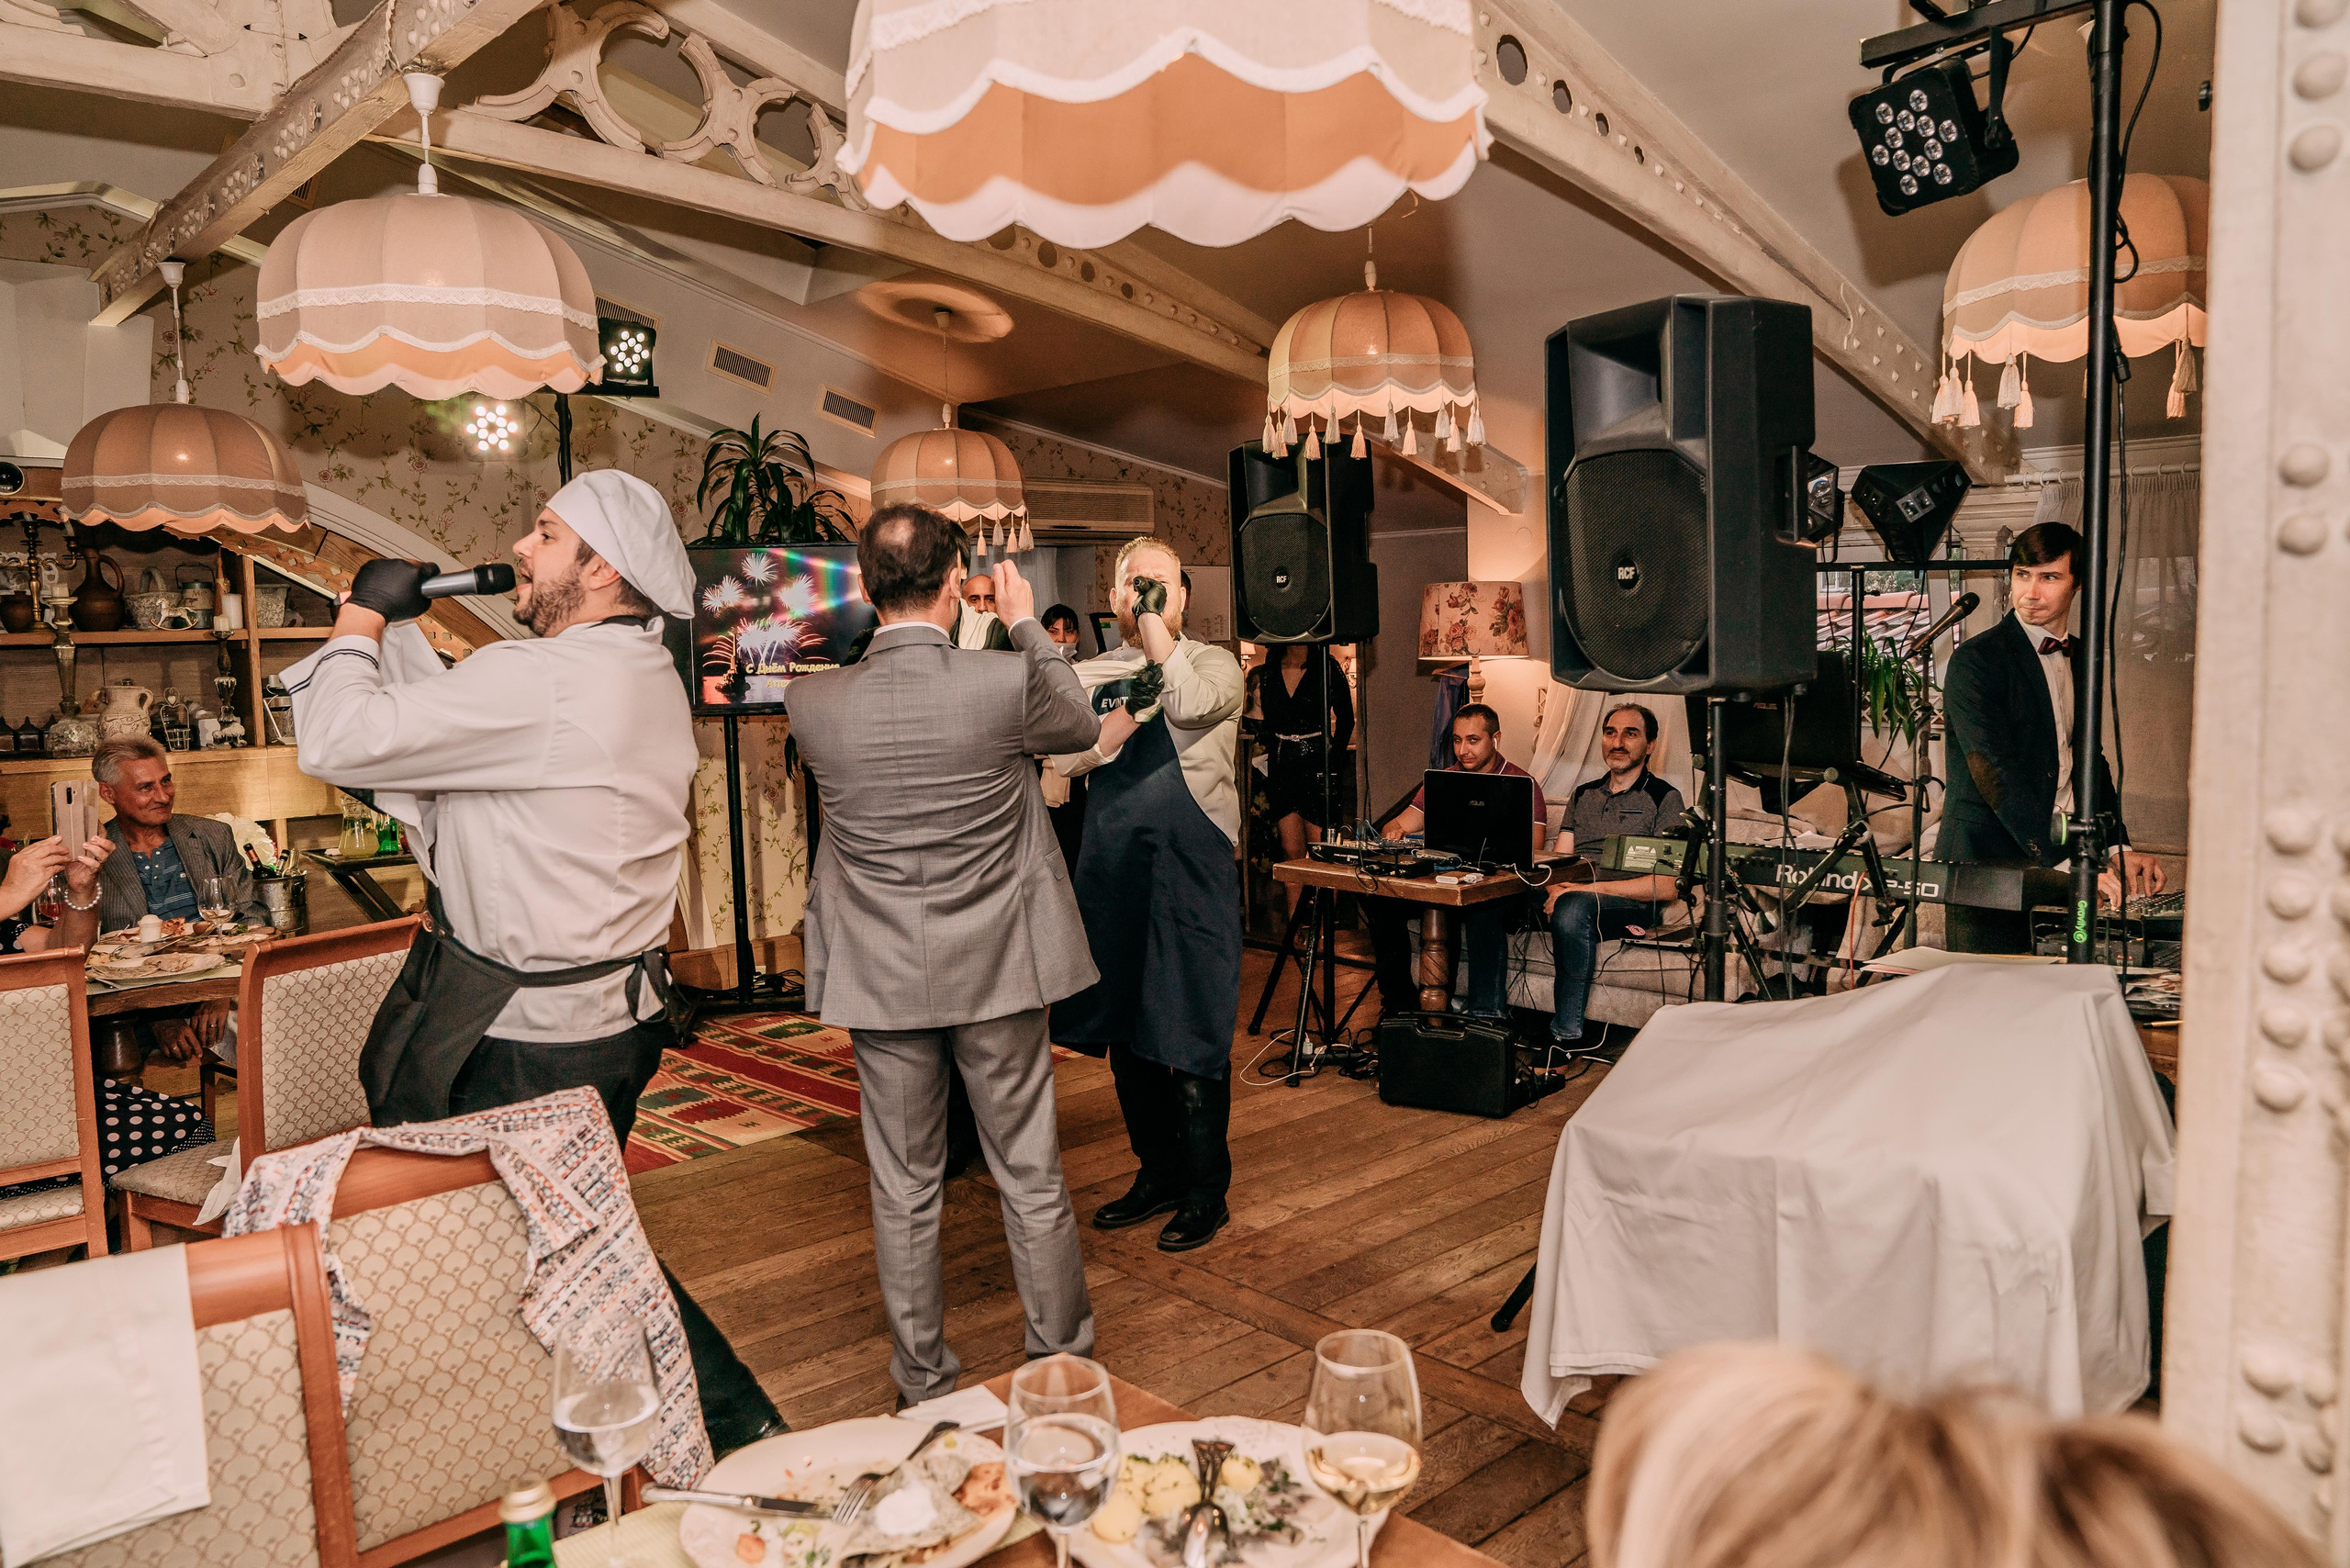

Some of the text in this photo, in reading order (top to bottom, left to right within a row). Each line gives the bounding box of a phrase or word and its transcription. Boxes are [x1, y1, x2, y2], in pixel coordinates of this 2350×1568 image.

[1276, 575, 1288, 584] RCF
[1617, 566, 1635, 580] RCF
[755, 662, 787, 675] Днём
[766, 679, 790, 689] Але
[1102, 696, 1128, 708] EVNT
[1775, 863, 1858, 890] Rond
[2075, 900, 2087, 931] Gravity
